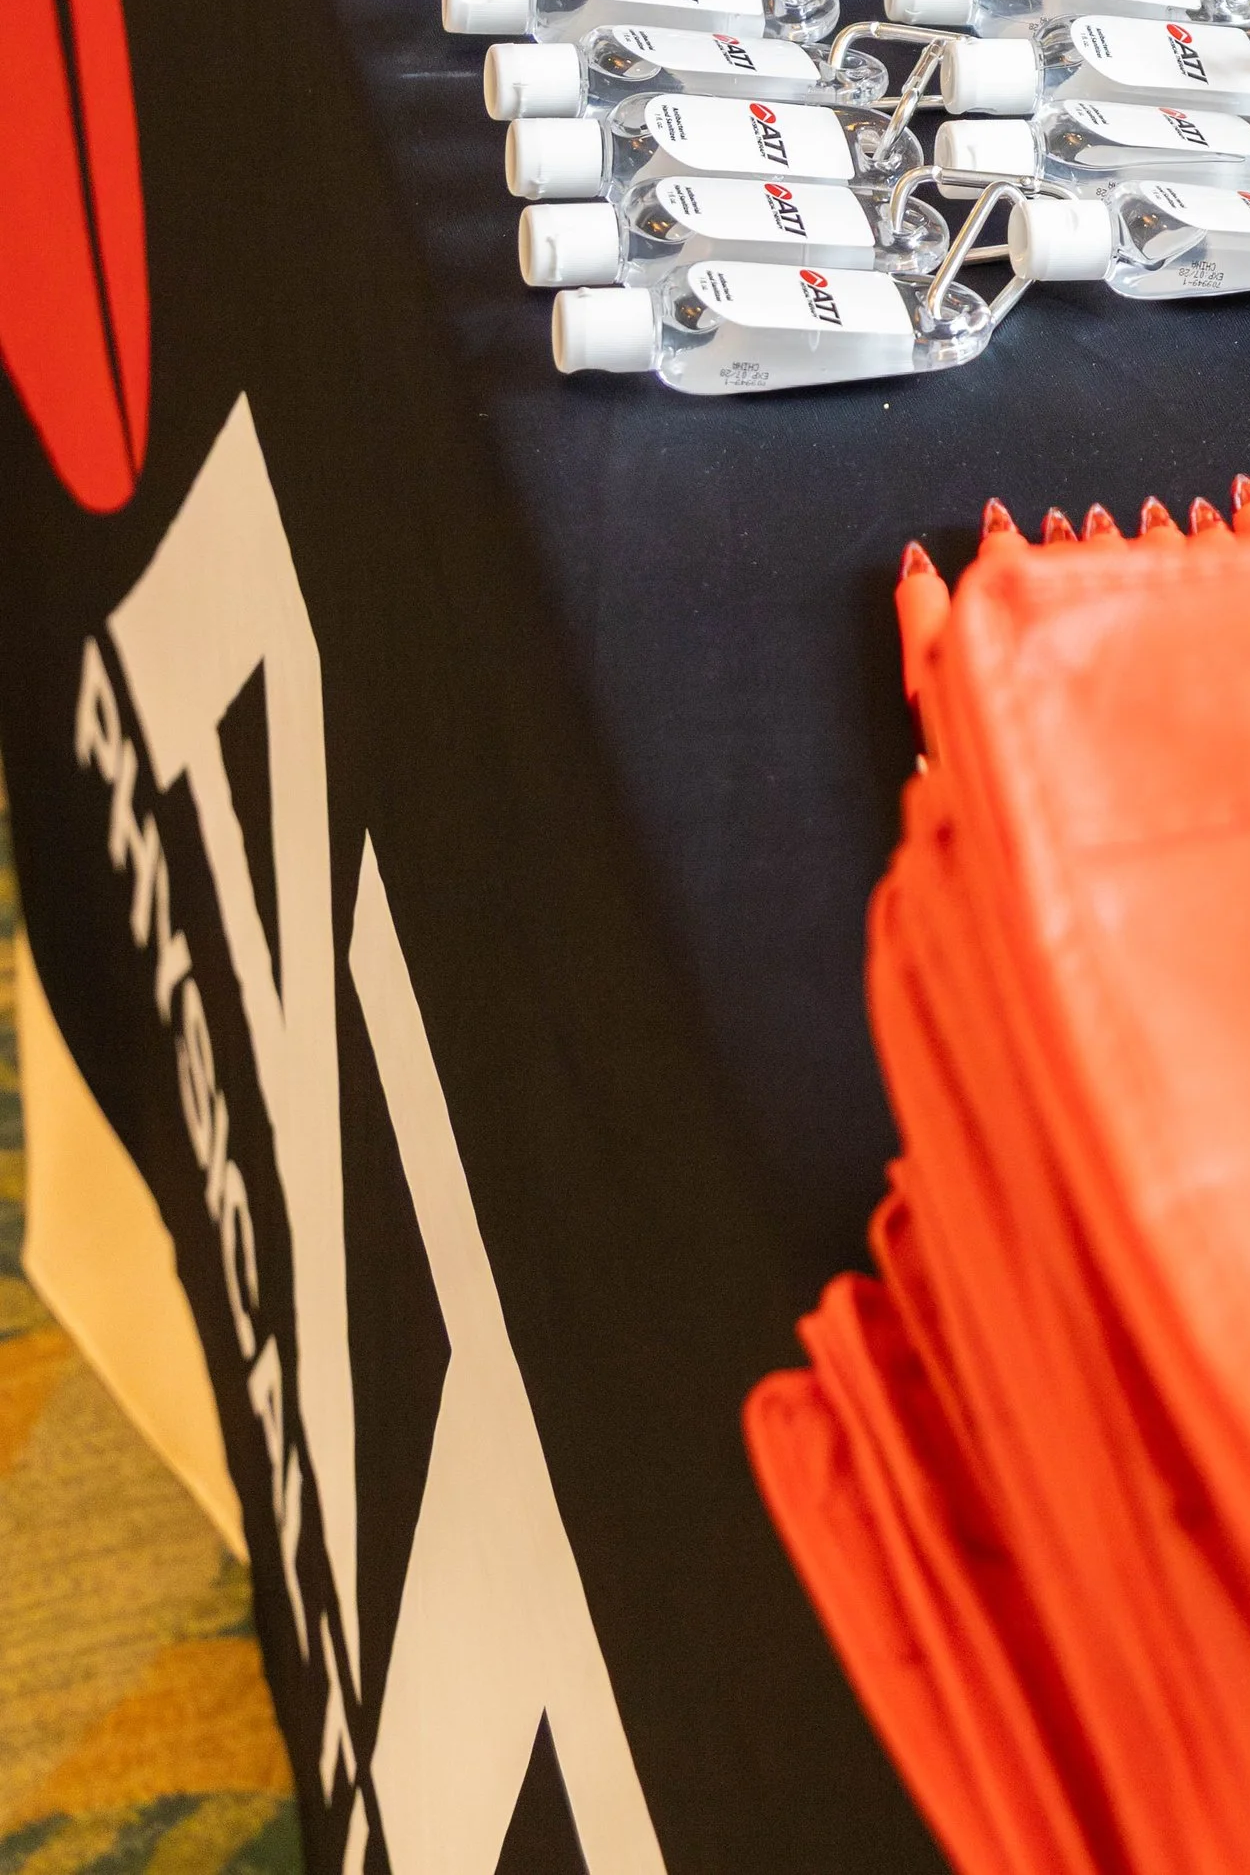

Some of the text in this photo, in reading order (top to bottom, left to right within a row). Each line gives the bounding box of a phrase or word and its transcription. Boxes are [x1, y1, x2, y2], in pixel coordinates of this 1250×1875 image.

[724, 43, 757, 72] ATI
[1174, 38, 1210, 86] ATI
[672, 106, 688, 141] Antibacterial
[1175, 117, 1211, 148] ATI
[755, 120, 790, 170] ATI
[772, 198, 808, 240] ATI
[1191, 260, 1217, 272] CHINA
[807, 284, 843, 327] ATI
[73, 634, 311, 1663] PHYSICAL
